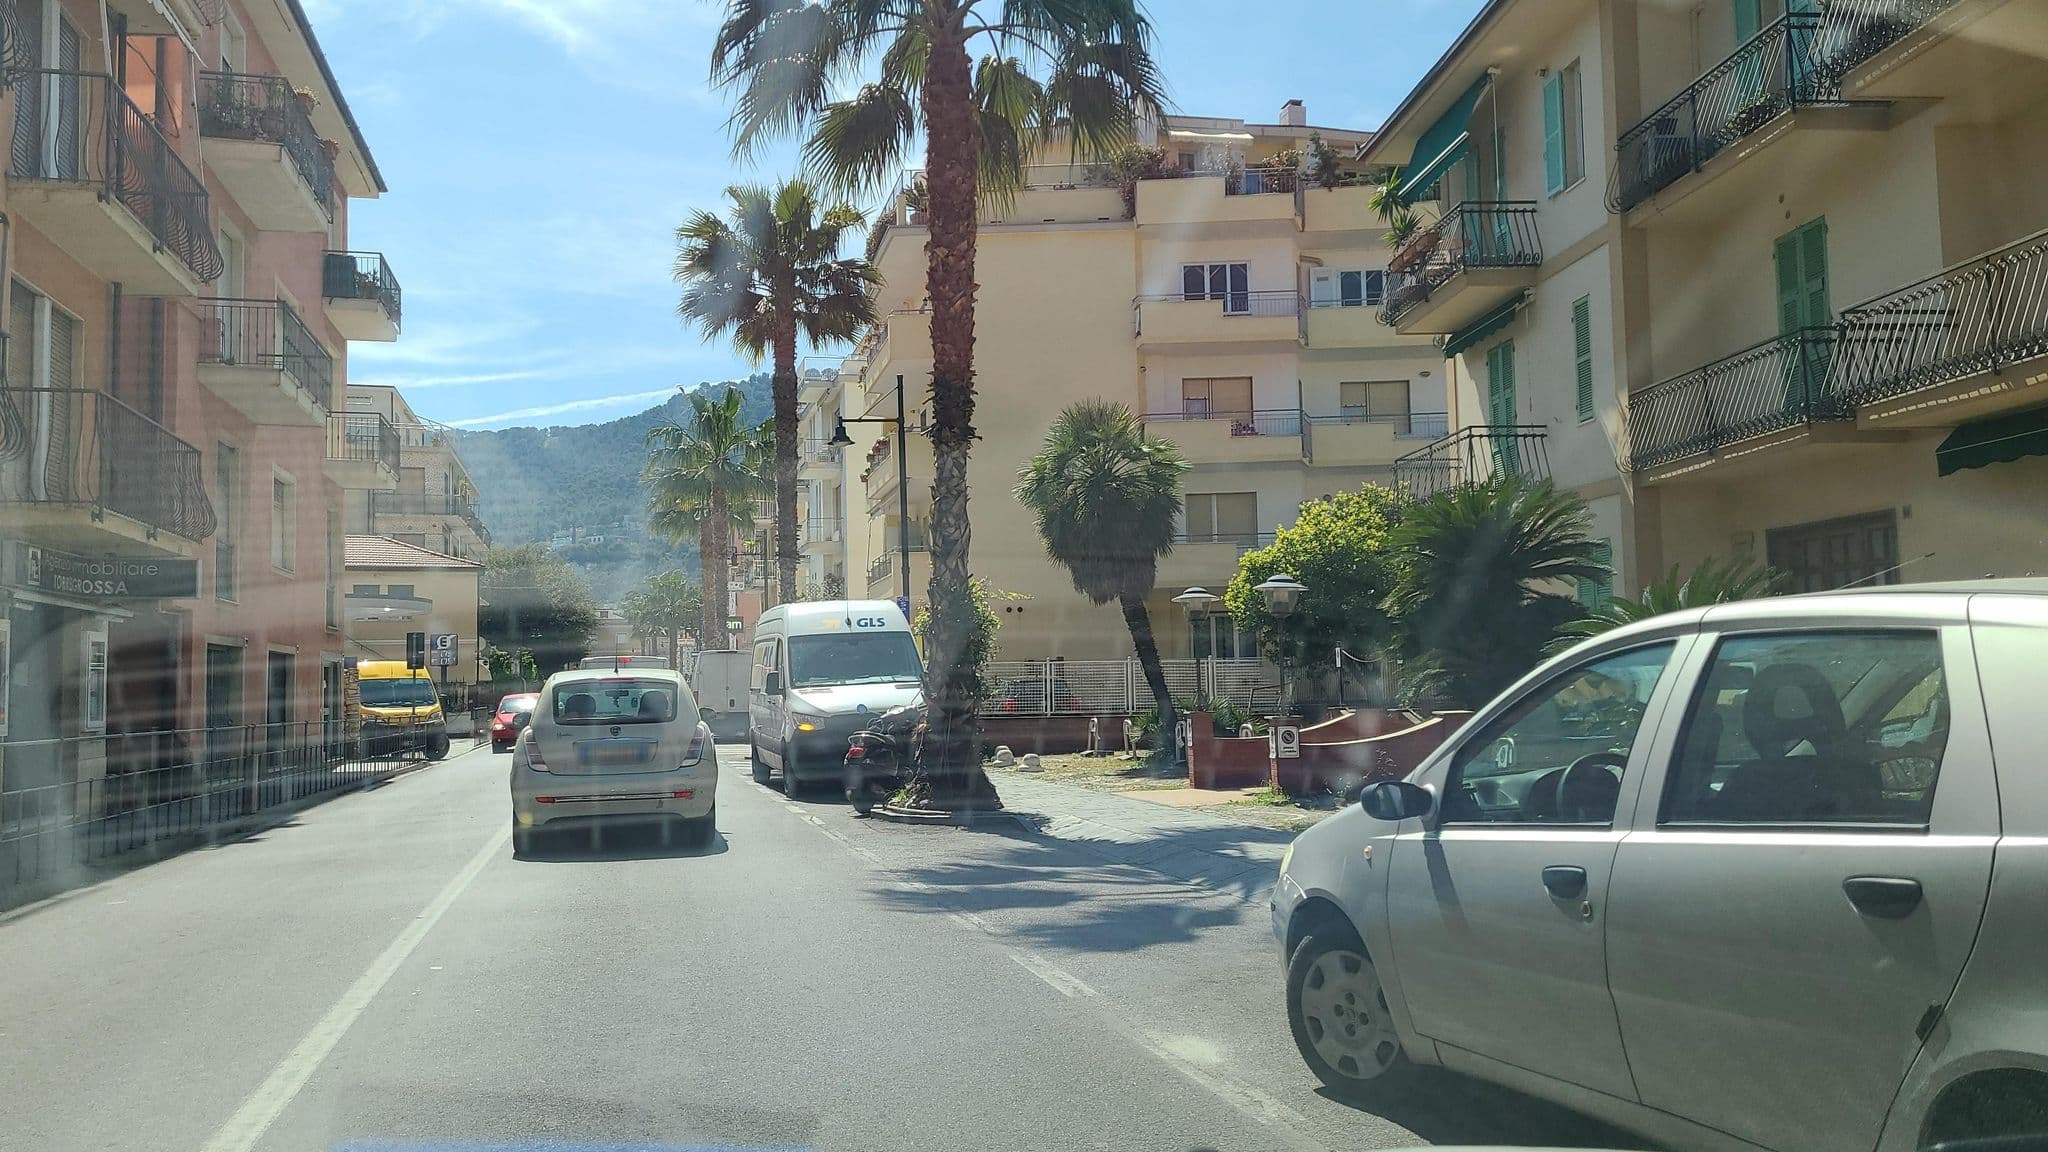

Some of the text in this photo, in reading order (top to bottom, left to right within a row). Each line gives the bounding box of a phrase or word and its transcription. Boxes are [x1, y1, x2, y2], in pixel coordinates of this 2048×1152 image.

[73, 559, 159, 577] mobiliare
[725, 620, 742, 629] am
[856, 617, 886, 628] GLS
